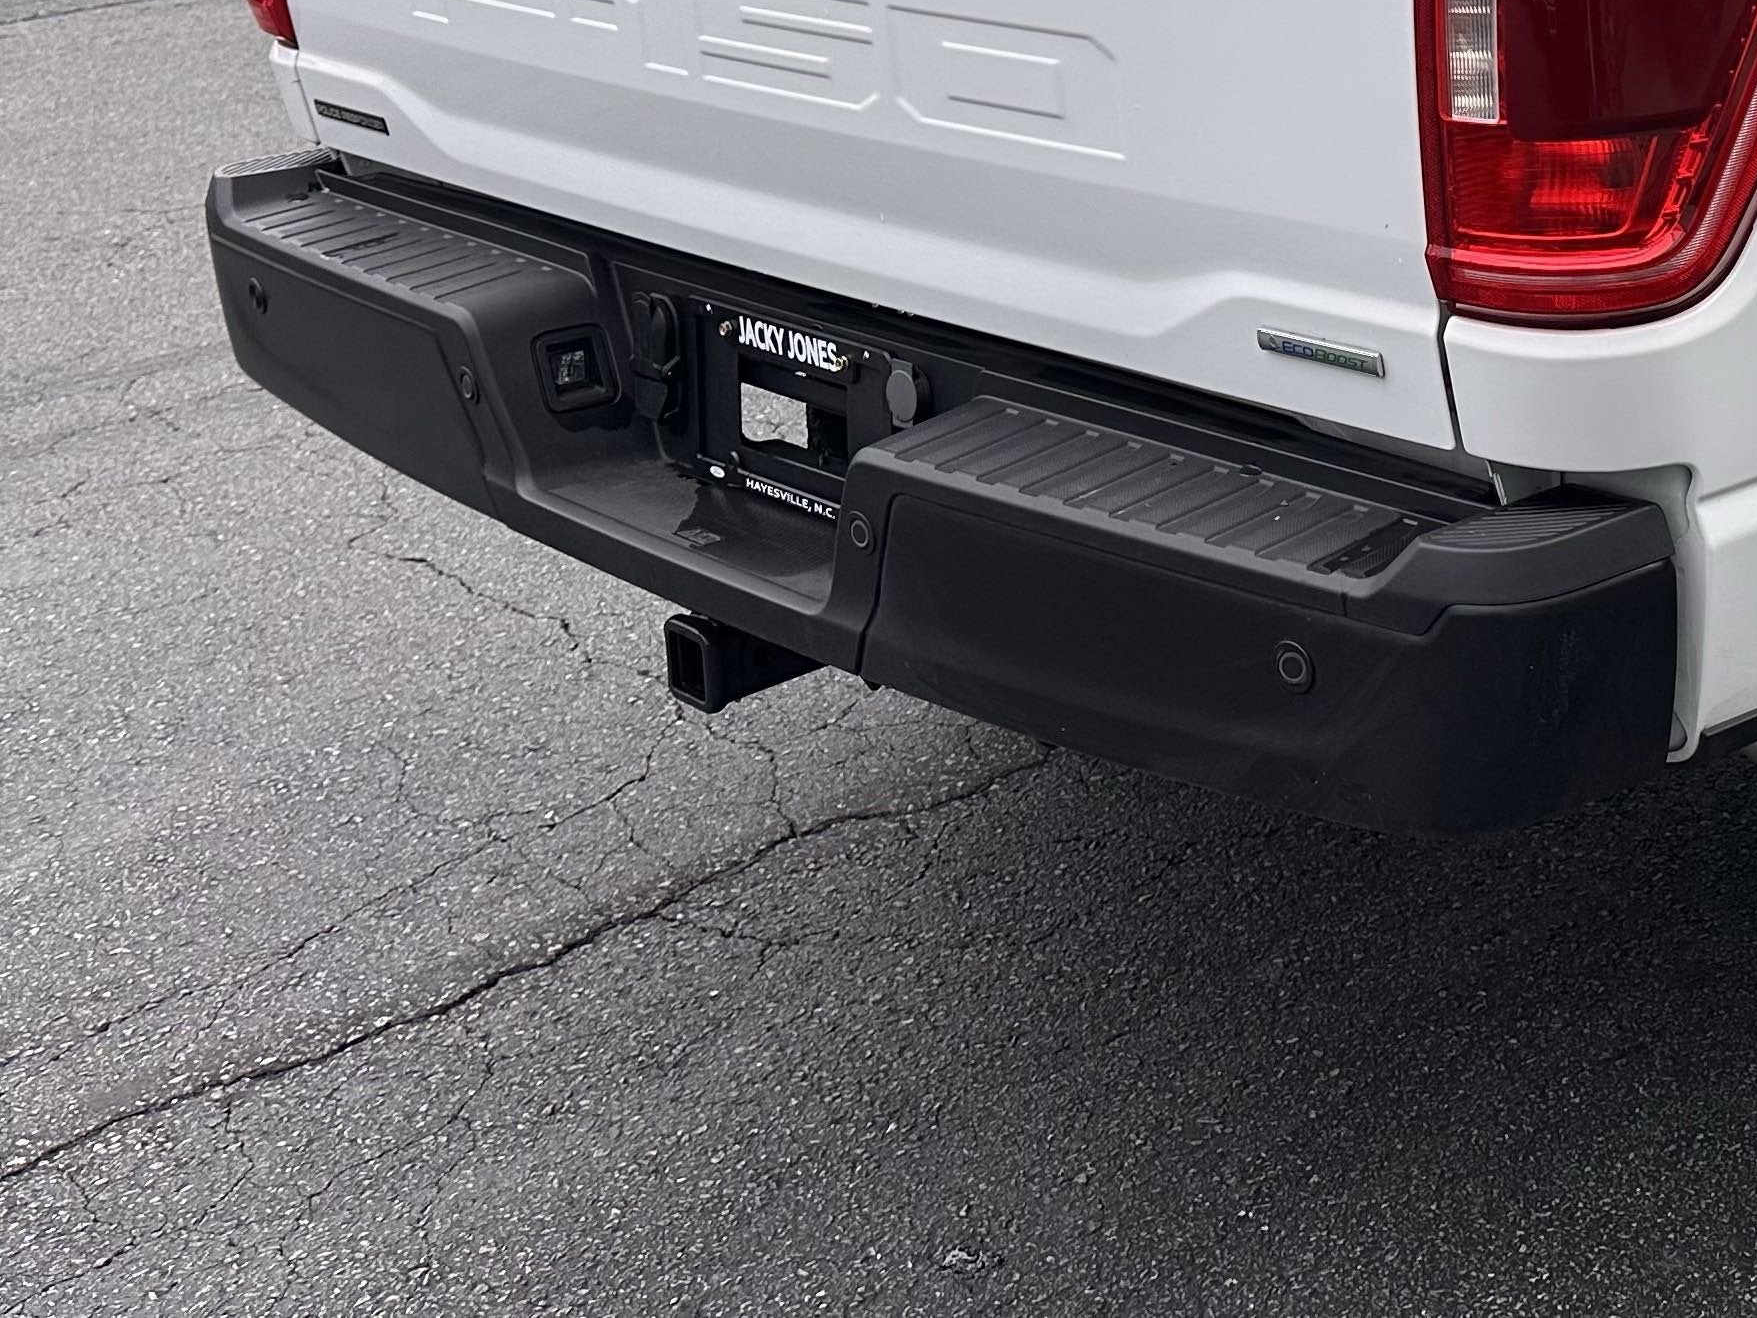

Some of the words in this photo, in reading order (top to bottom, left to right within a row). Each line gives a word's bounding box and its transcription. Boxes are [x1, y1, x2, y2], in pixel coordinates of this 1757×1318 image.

[738, 315, 784, 356] JACKY
[787, 330, 842, 373] JONES
[745, 477, 812, 512] HAYESVILLE,
[814, 502, 836, 520] N.C.
